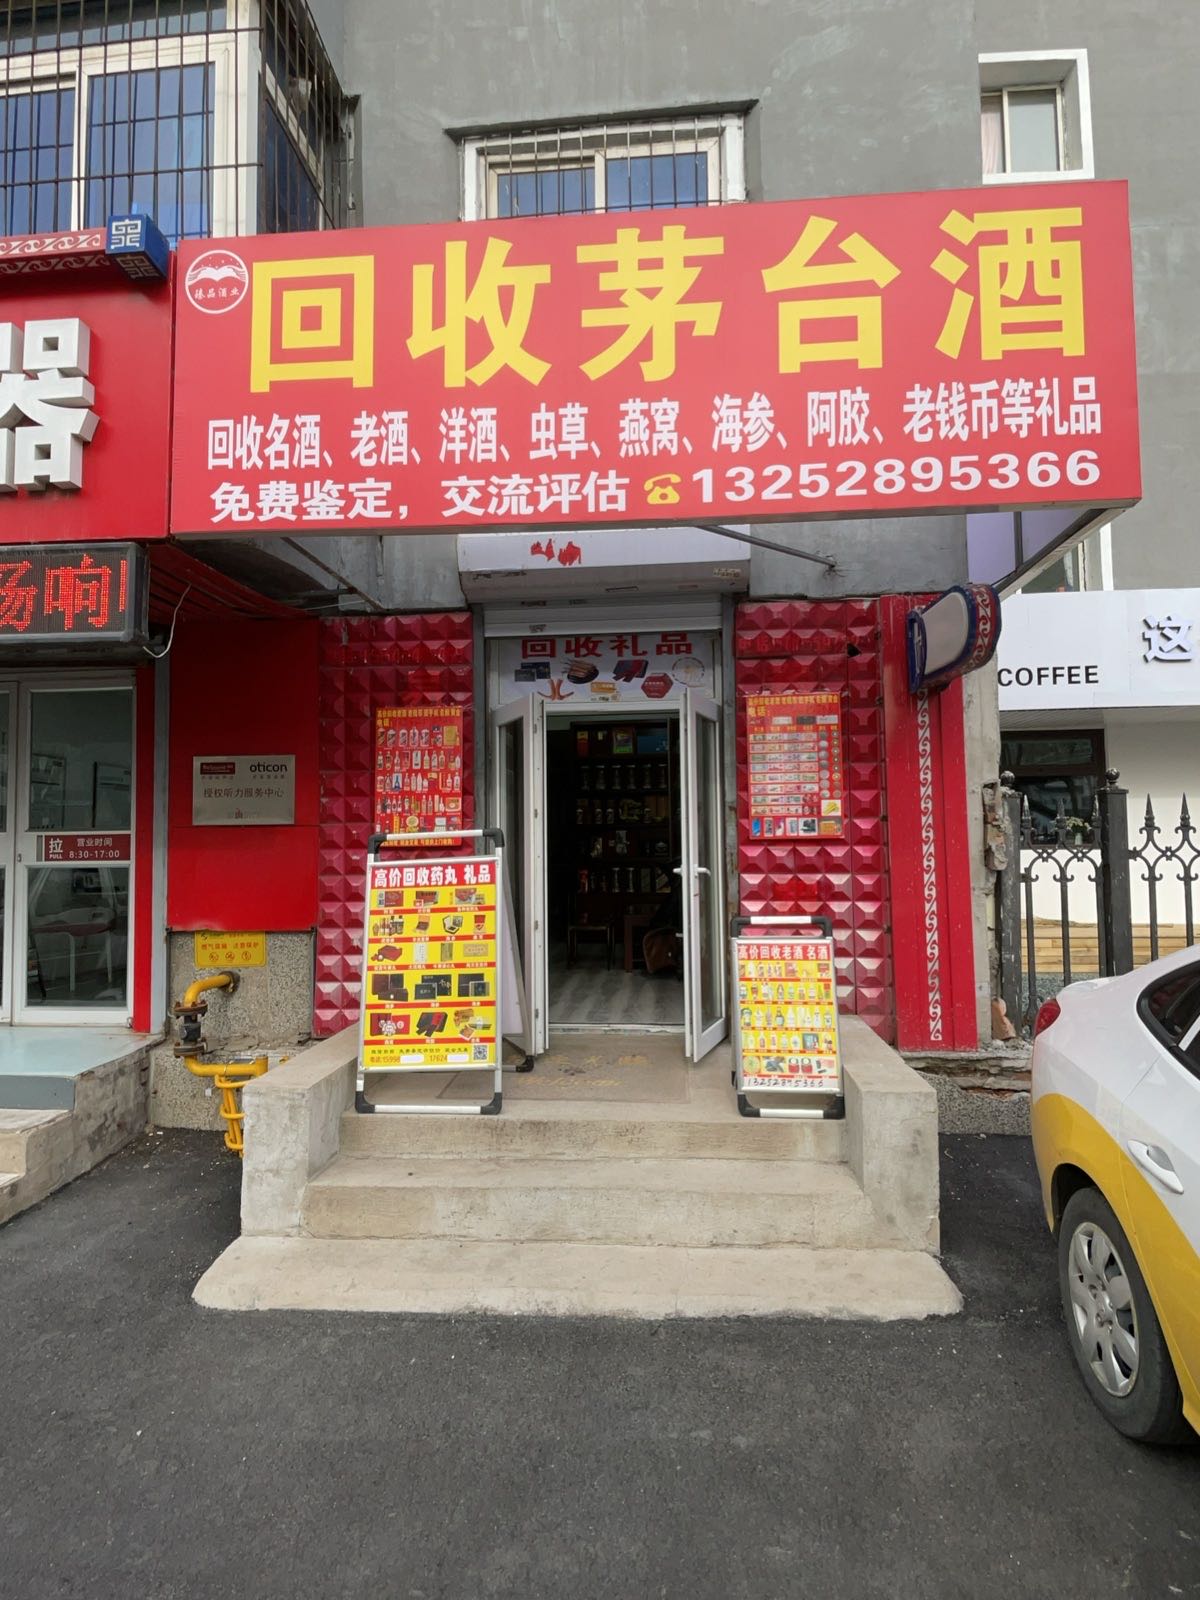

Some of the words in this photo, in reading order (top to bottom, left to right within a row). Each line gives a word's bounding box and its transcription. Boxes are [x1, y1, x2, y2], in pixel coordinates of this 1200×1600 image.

[249, 207, 1085, 394] 回收茅台酒
[692, 450, 1101, 505] 13252895366
[520, 632, 693, 659] 回收礼品
[1142, 616, 1194, 663] 这
[997, 665, 1099, 687] COFFEE
[249, 762, 288, 773] oticon
[203, 787, 284, 798] 授权听力服务中心
[49, 838, 63, 854] 拉
[77, 837, 113, 847] 营业时间
[69, 850, 120, 859] 8:30-17:00
[374, 865, 458, 888] 高价回收药丸
[464, 864, 491, 885] 礼品
[738, 945, 804, 960] 高价回收老酒
[807, 944, 828, 960] 名酒
